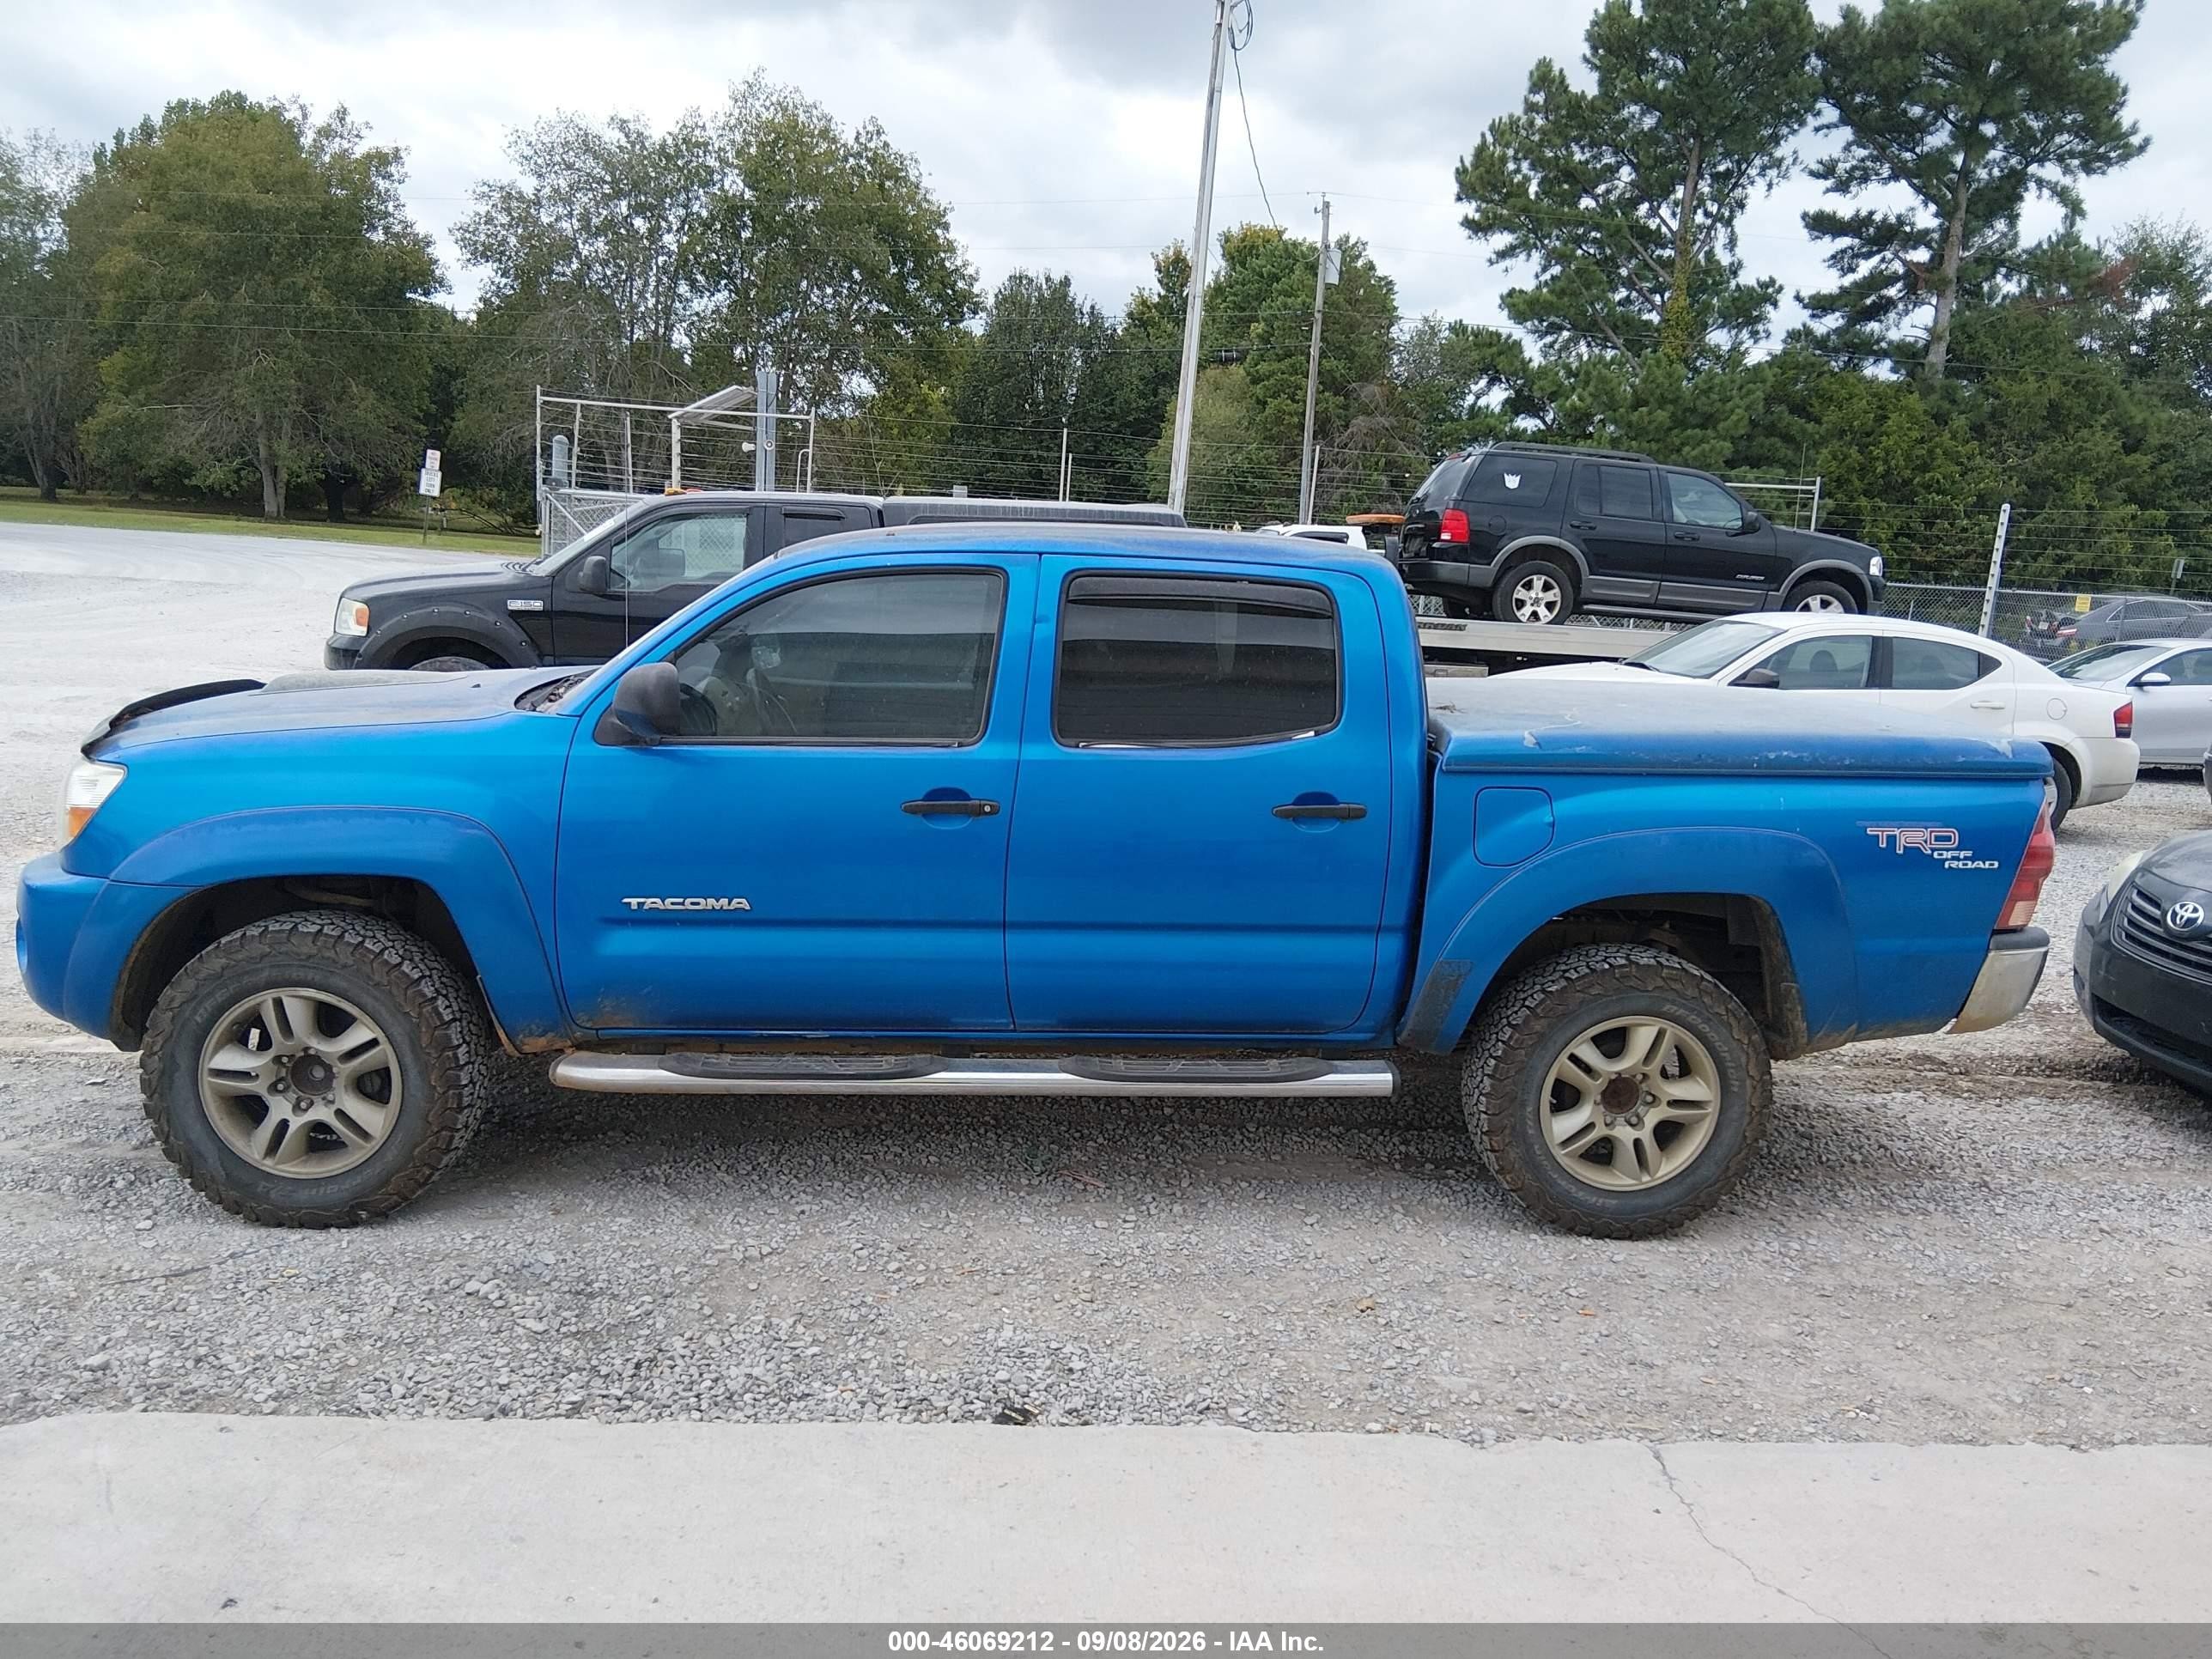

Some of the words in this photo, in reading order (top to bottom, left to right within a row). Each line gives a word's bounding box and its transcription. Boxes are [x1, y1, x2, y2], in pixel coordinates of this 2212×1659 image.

[1867, 828, 1959, 854] TRD
[1933, 850, 1973, 860] OFF
[1944, 860, 1999, 869] ROAD
[622, 897, 751, 910] TACOMA
